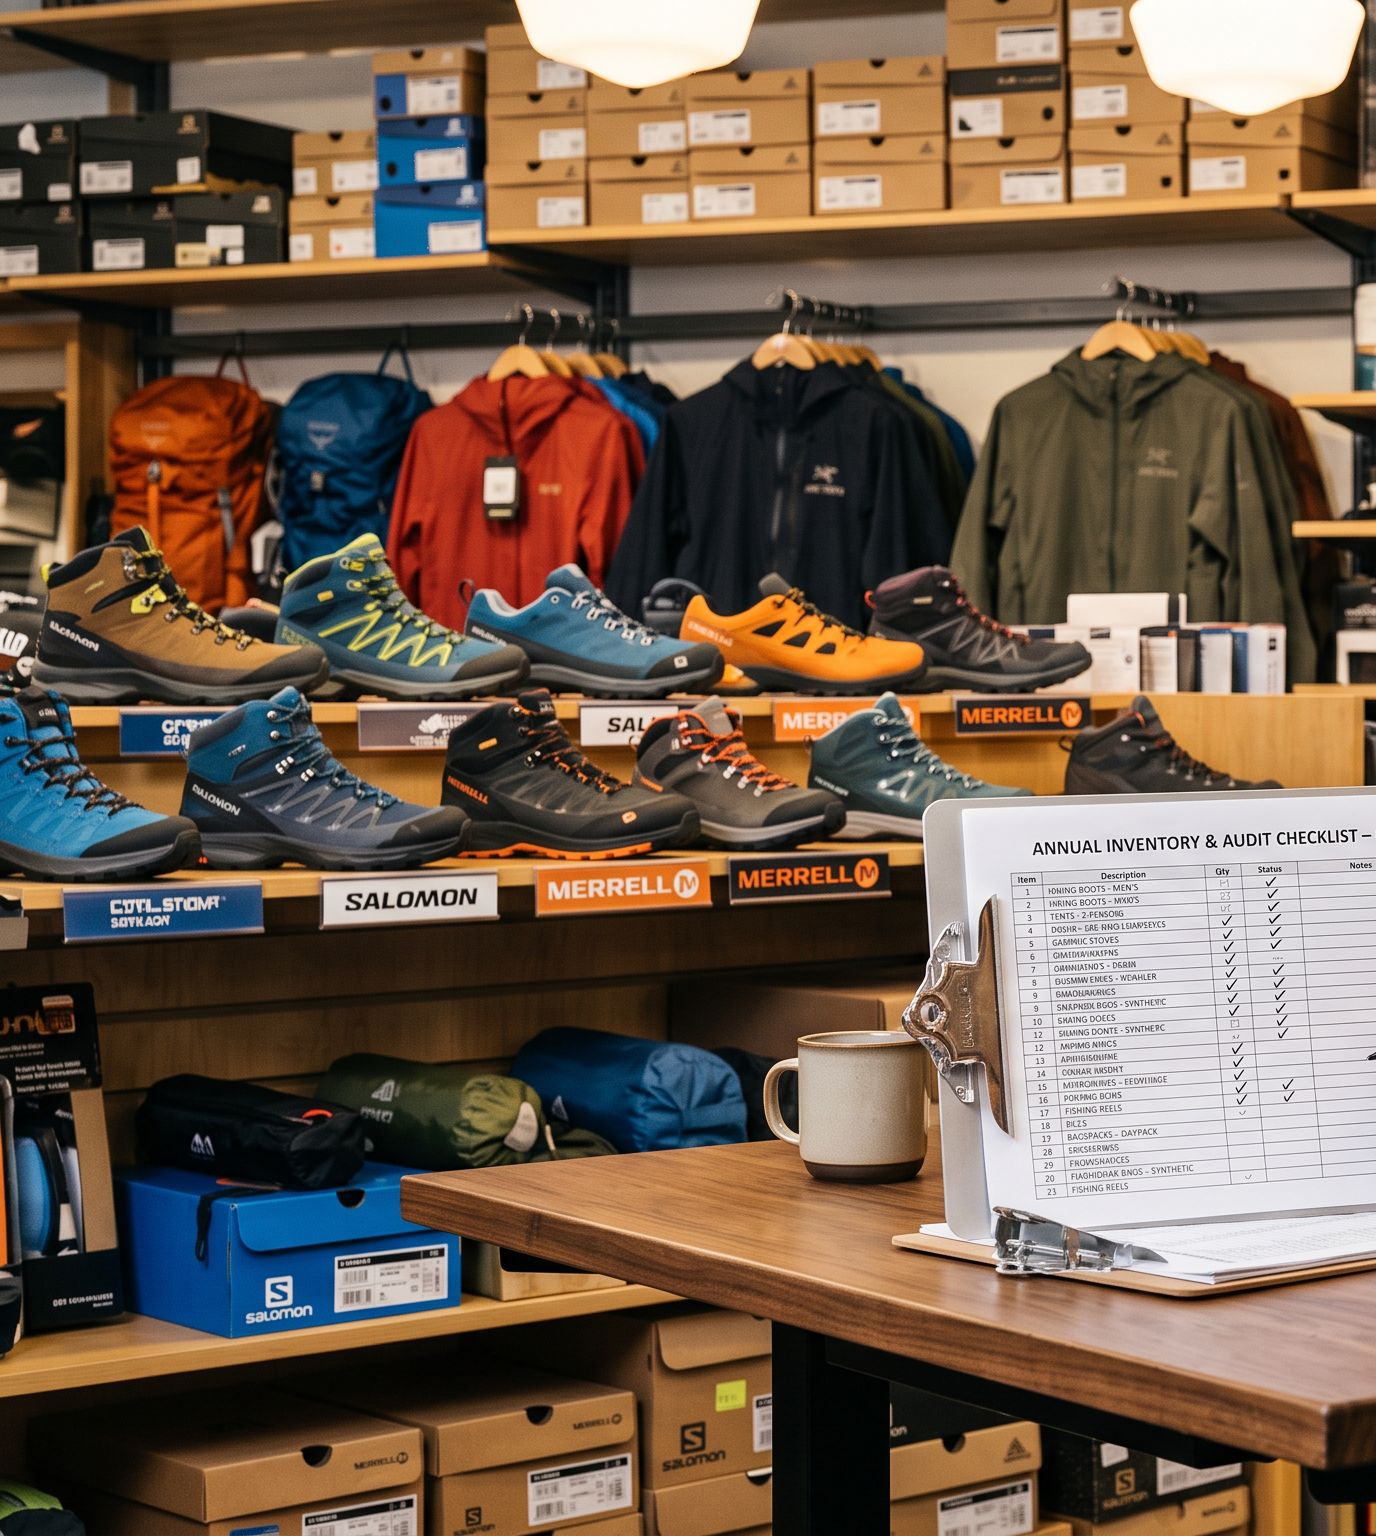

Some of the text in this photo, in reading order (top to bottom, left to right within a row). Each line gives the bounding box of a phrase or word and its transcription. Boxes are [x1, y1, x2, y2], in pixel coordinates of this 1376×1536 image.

[961, 706, 1059, 725] MERRELL
[1032, 839, 1102, 856] ANNUAL
[1106, 835, 1200, 853] INVENTORY
[1205, 834, 1218, 849] &
[1222, 832, 1271, 848] AUDIT
[1276, 829, 1358, 845] CHECKLIST
[1017, 876, 1037, 884] Item
[1100, 871, 1147, 881] Description
[1257, 865, 1283, 874] Status
[1349, 861, 1373, 870] Notes
[738, 865, 853, 889] MERRELL
[547, 875, 671, 900] MERRELL
[1025, 888, 1030, 896] 1
[1078, 884, 1106, 894] BOOTS
[1112, 883, 1139, 892] MEN'S
[345, 888, 478, 912] SALOMON
[1026, 901, 1031, 909] 2
[1079, 897, 1107, 907] BOOTS
[1027, 914, 1032, 922] 3
[1050, 911, 1075, 921] TENTS
[1027, 927, 1033, 935] 4
[1028, 940, 1034, 948] 5
[1089, 936, 1120, 945] STOVES
[1030, 953, 1035, 961] 6
[1031, 966, 1036, 974] 7
[1032, 979, 1037, 987] 8
[1032, 992, 1038, 1000] 9
[1033, 1005, 1039, 1013] 9
[1032, 1018, 1043, 1026] 10
[1033, 1031, 1043, 1039] 12
[1034, 1044, 1044, 1052] 12
[1035, 1057, 1045, 1065] 13
[1036, 1070, 1046, 1078] 14
[1037, 1083, 1047, 1091] 15
[1038, 1096, 1049, 1104] 16
[1040, 1104, 1123, 1117] 17 FISHING REELS
[1041, 1122, 1051, 1130] 18
[1121, 1127, 1158, 1138] DAYPACK
[1042, 1148, 1053, 1156] 28
[1043, 1161, 1054, 1169] 29
[1045, 1174, 1055, 1183] 20
[1151, 1164, 1195, 1175] SYNTHETIC
[1047, 1182, 1129, 1196] 23 FISHING REELS
